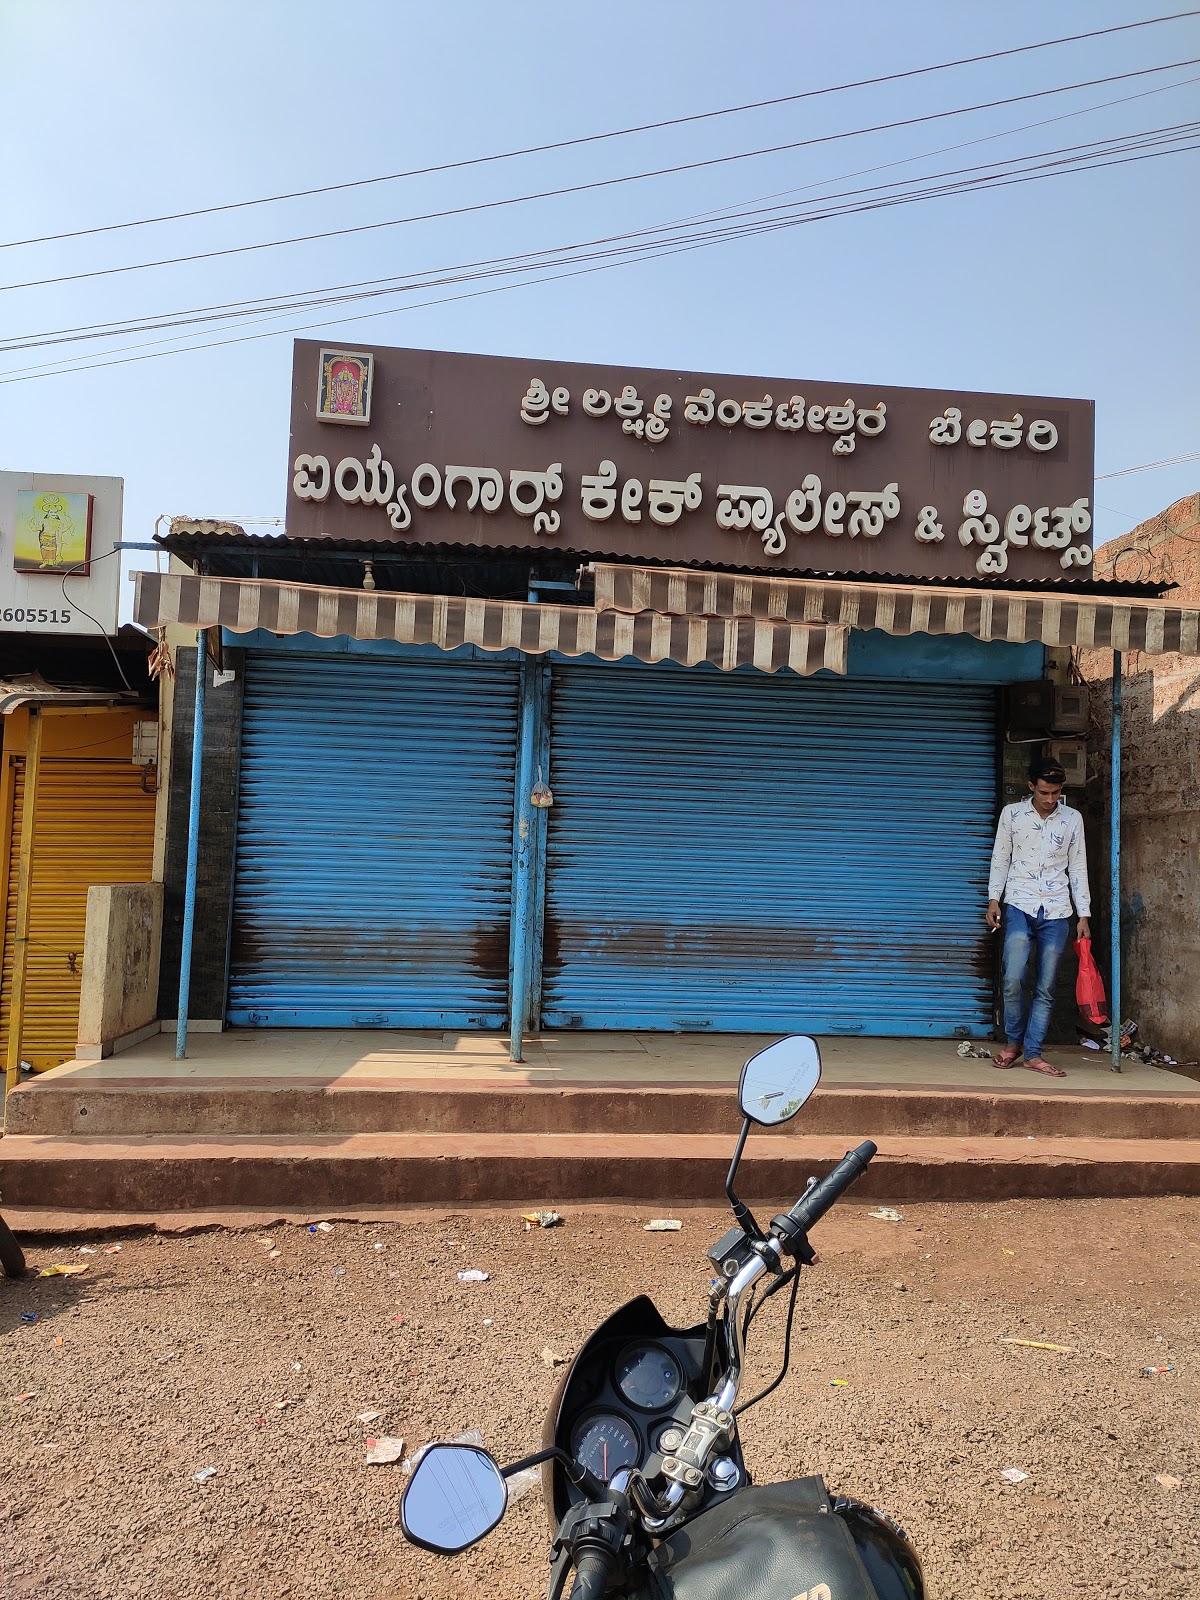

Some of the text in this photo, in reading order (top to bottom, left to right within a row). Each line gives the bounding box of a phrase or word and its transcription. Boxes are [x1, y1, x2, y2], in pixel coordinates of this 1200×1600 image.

[520, 378, 570, 425] ಶ್ರೀ
[684, 388, 886, 456] ವೆಂಕಟೇಶ್ವರ
[928, 407, 1059, 453] ಬೇಕರಿ
[581, 459, 703, 526] ಕೇಕ್
[715, 473, 901, 558] ಪ್ಯಾಲೇಸ್
[914, 505, 946, 544] &
[958, 489, 1093, 576] ಸ್ವೀಟ್ಸ್
[0, 608, 71, 624] 605515
